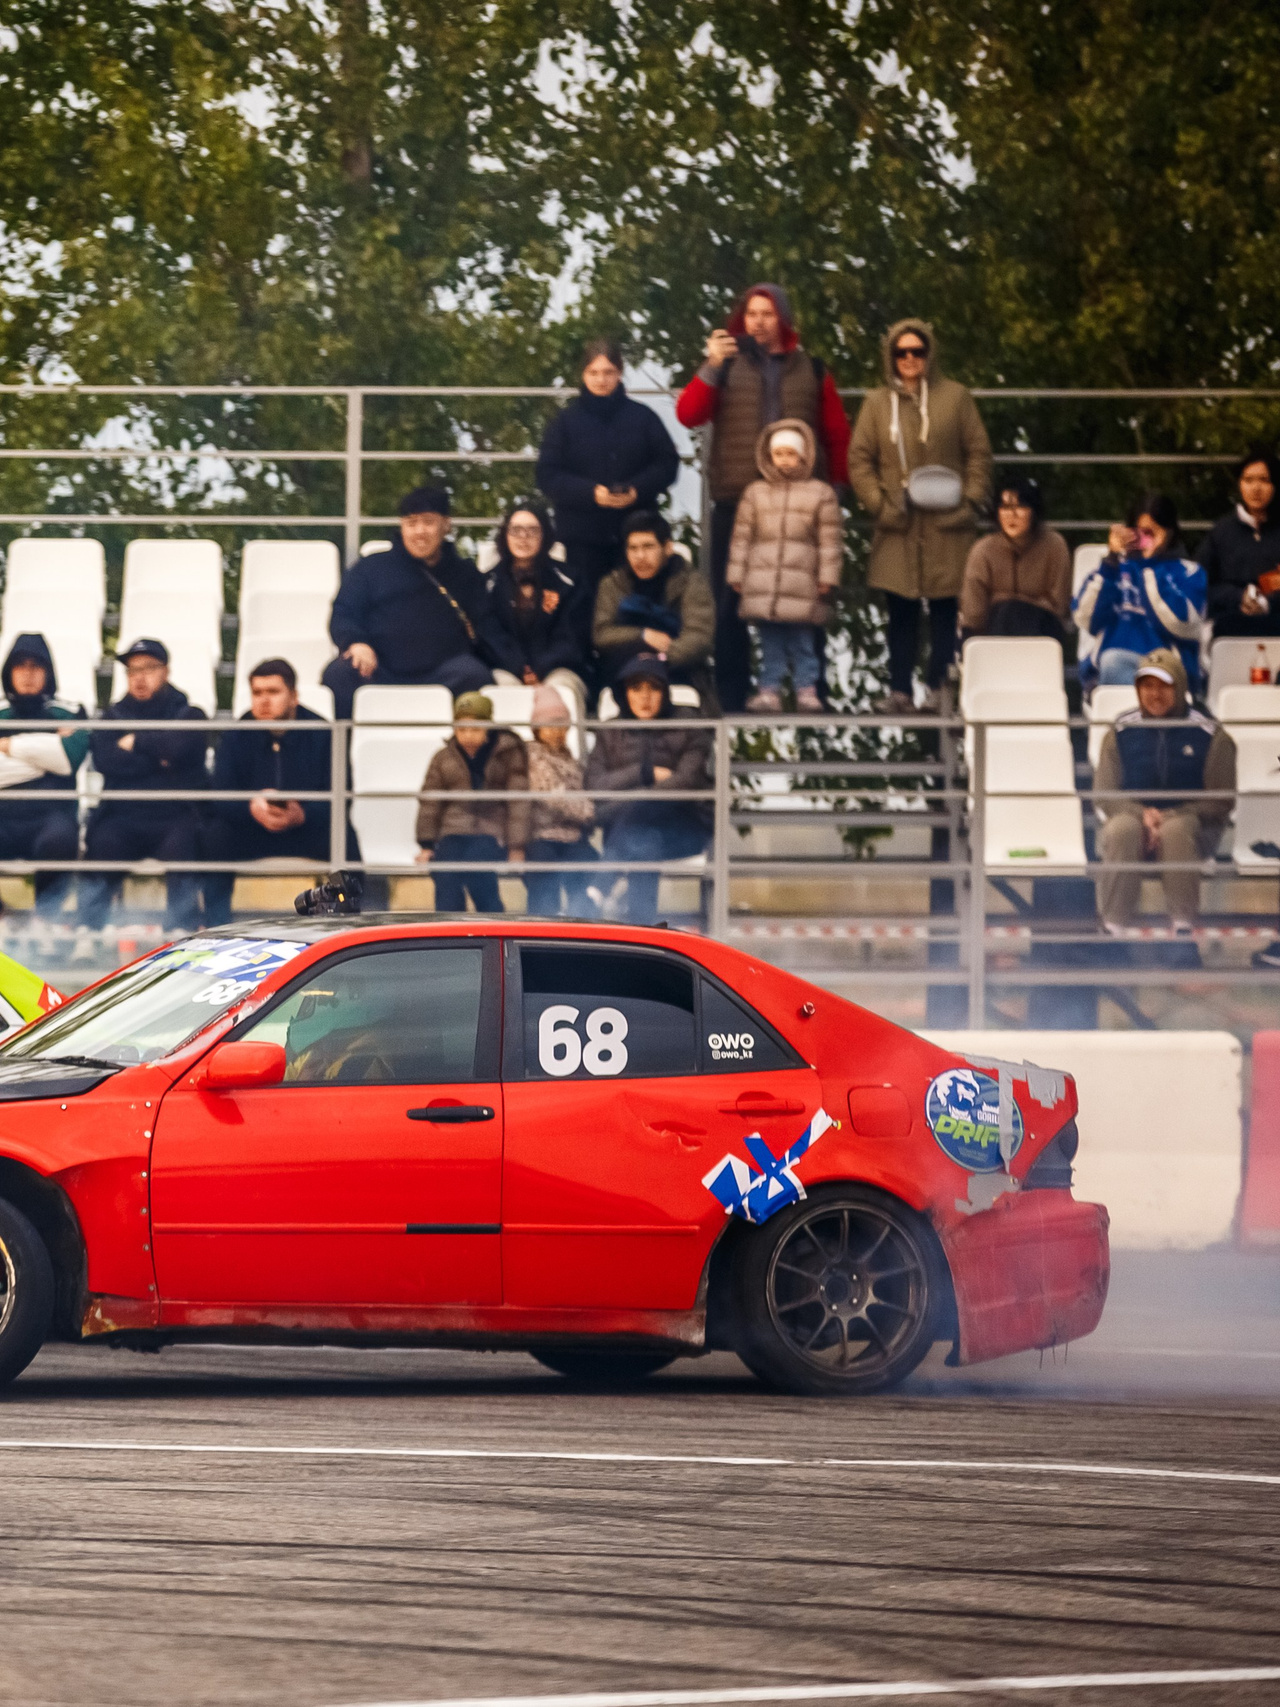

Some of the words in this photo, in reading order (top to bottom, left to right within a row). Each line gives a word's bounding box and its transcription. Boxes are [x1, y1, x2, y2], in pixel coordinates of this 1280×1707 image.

[192, 978, 254, 1005] 68
[539, 1005, 628, 1077] 68
[708, 1033, 755, 1050] OWO
[977, 1109, 1000, 1125] GORIL
[935, 1114, 1001, 1150] DRIF
